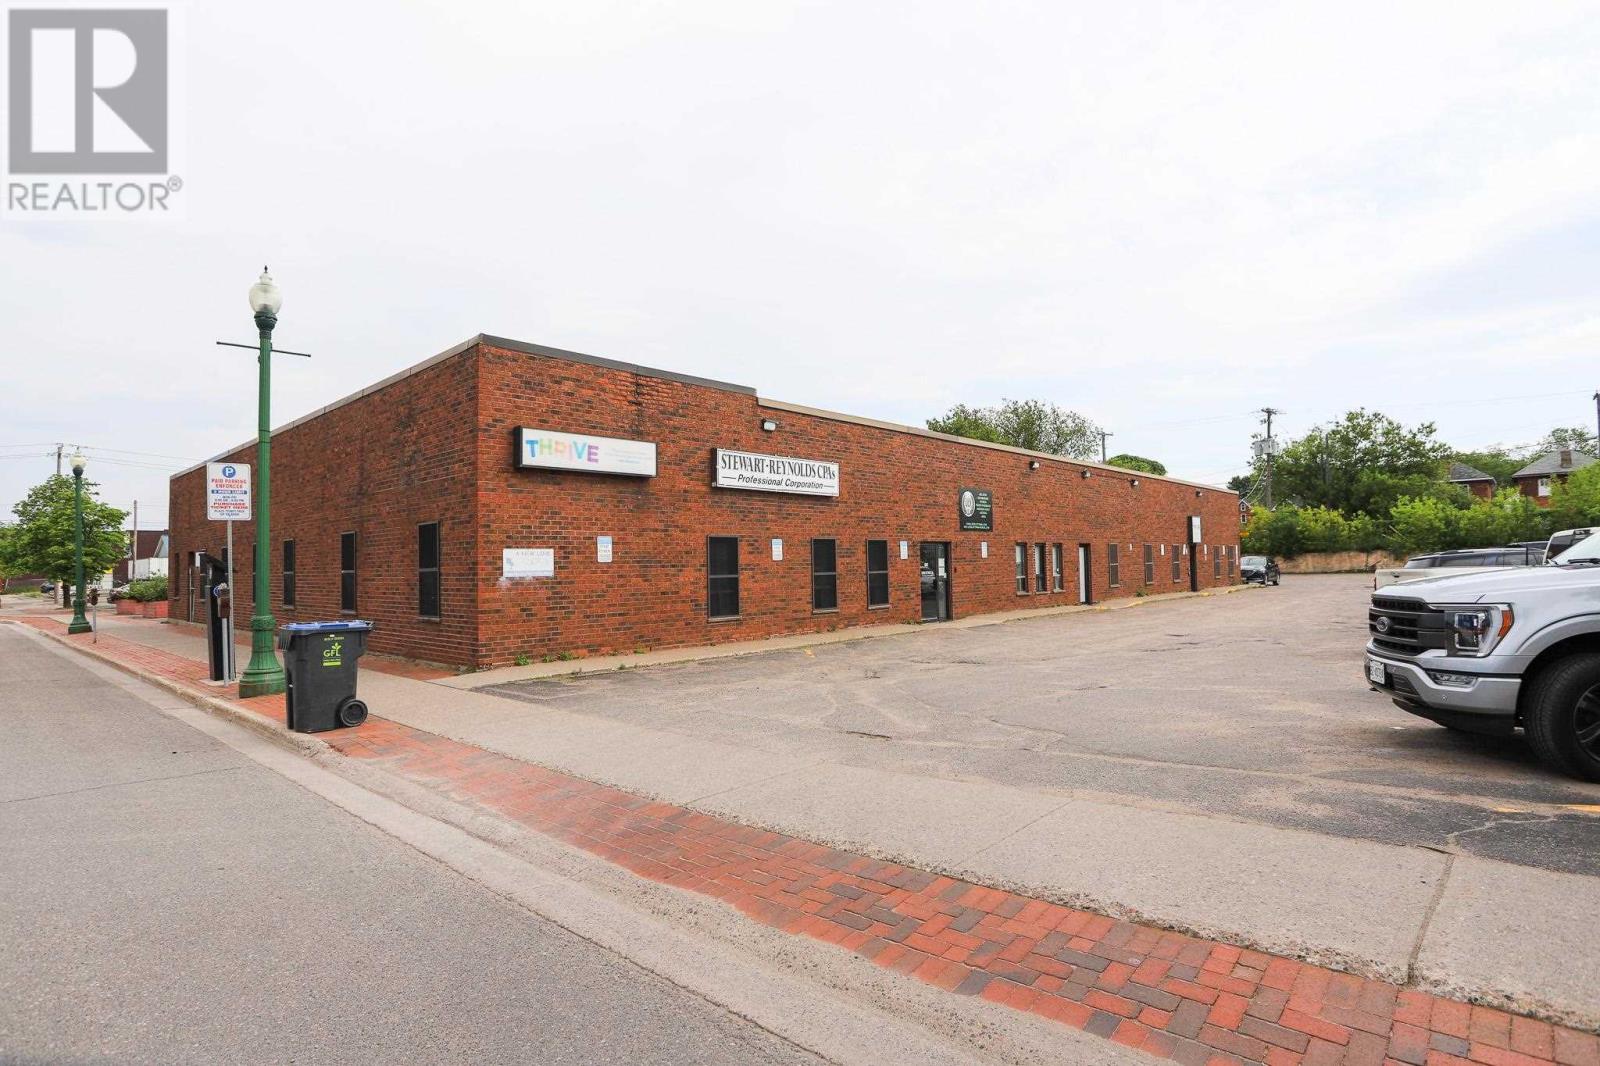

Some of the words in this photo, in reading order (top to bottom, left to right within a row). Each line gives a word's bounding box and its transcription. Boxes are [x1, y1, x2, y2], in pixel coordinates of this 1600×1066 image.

[525, 438, 599, 463] THRIVE
[226, 467, 233, 476] P
[737, 474, 783, 487] Professional
[785, 478, 824, 489] Corporation
